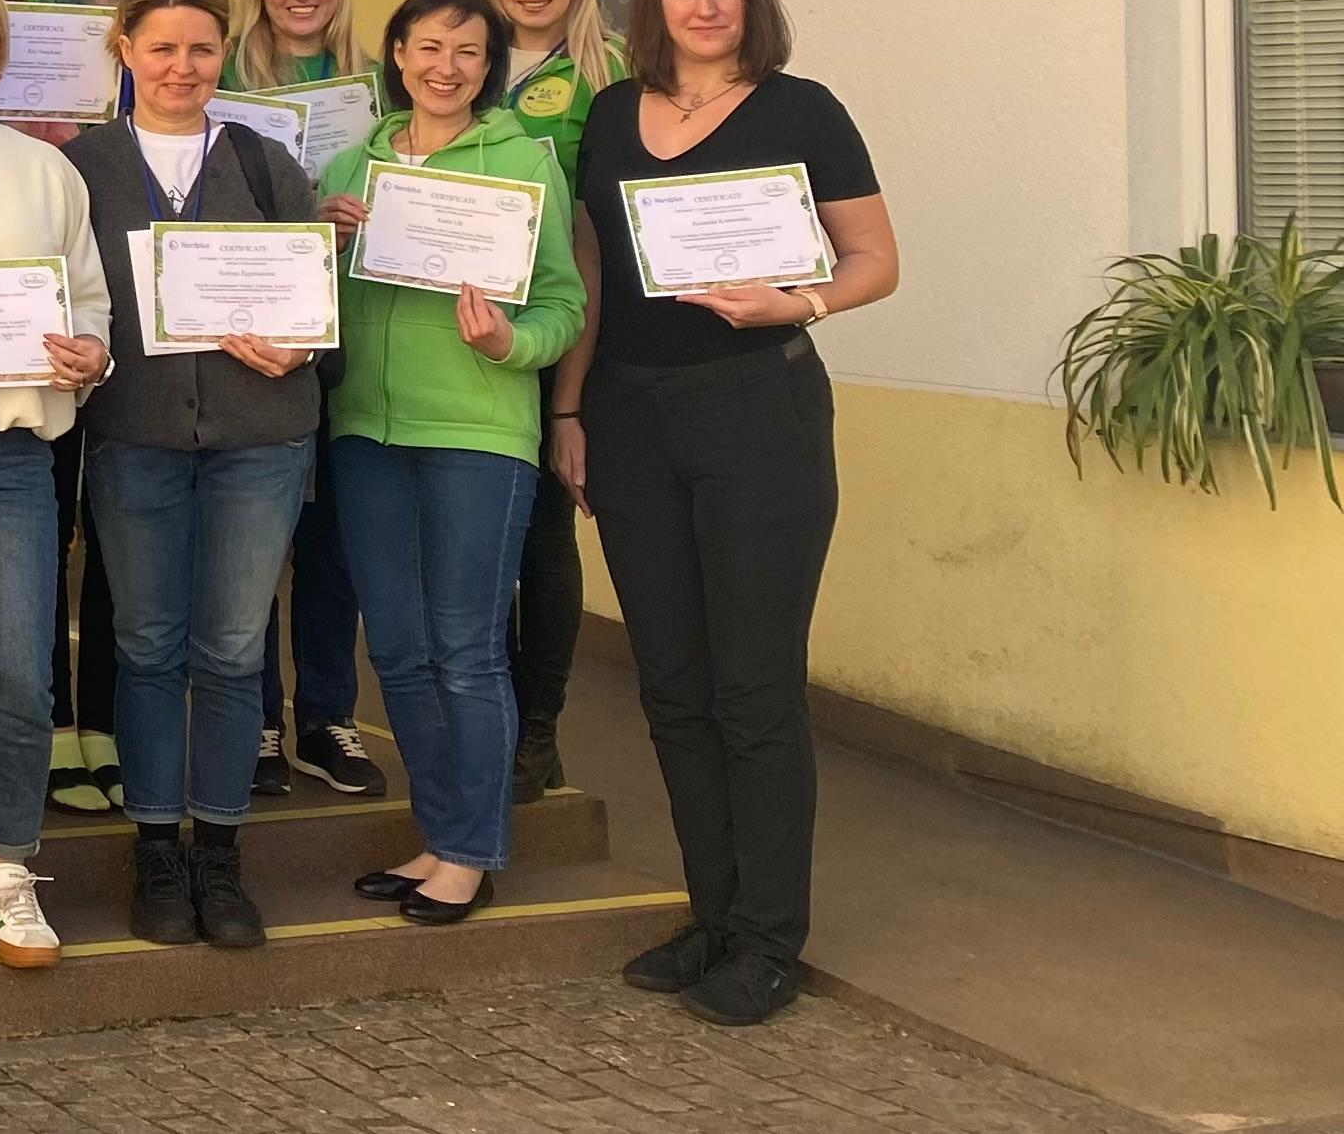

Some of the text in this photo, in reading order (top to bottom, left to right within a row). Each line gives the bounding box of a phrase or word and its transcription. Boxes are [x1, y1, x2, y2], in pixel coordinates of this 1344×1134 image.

[430, 192, 477, 205] CERTIFICATE
[693, 192, 743, 204] CERTIFICATE
[219, 244, 269, 253] CERTIFICATE
